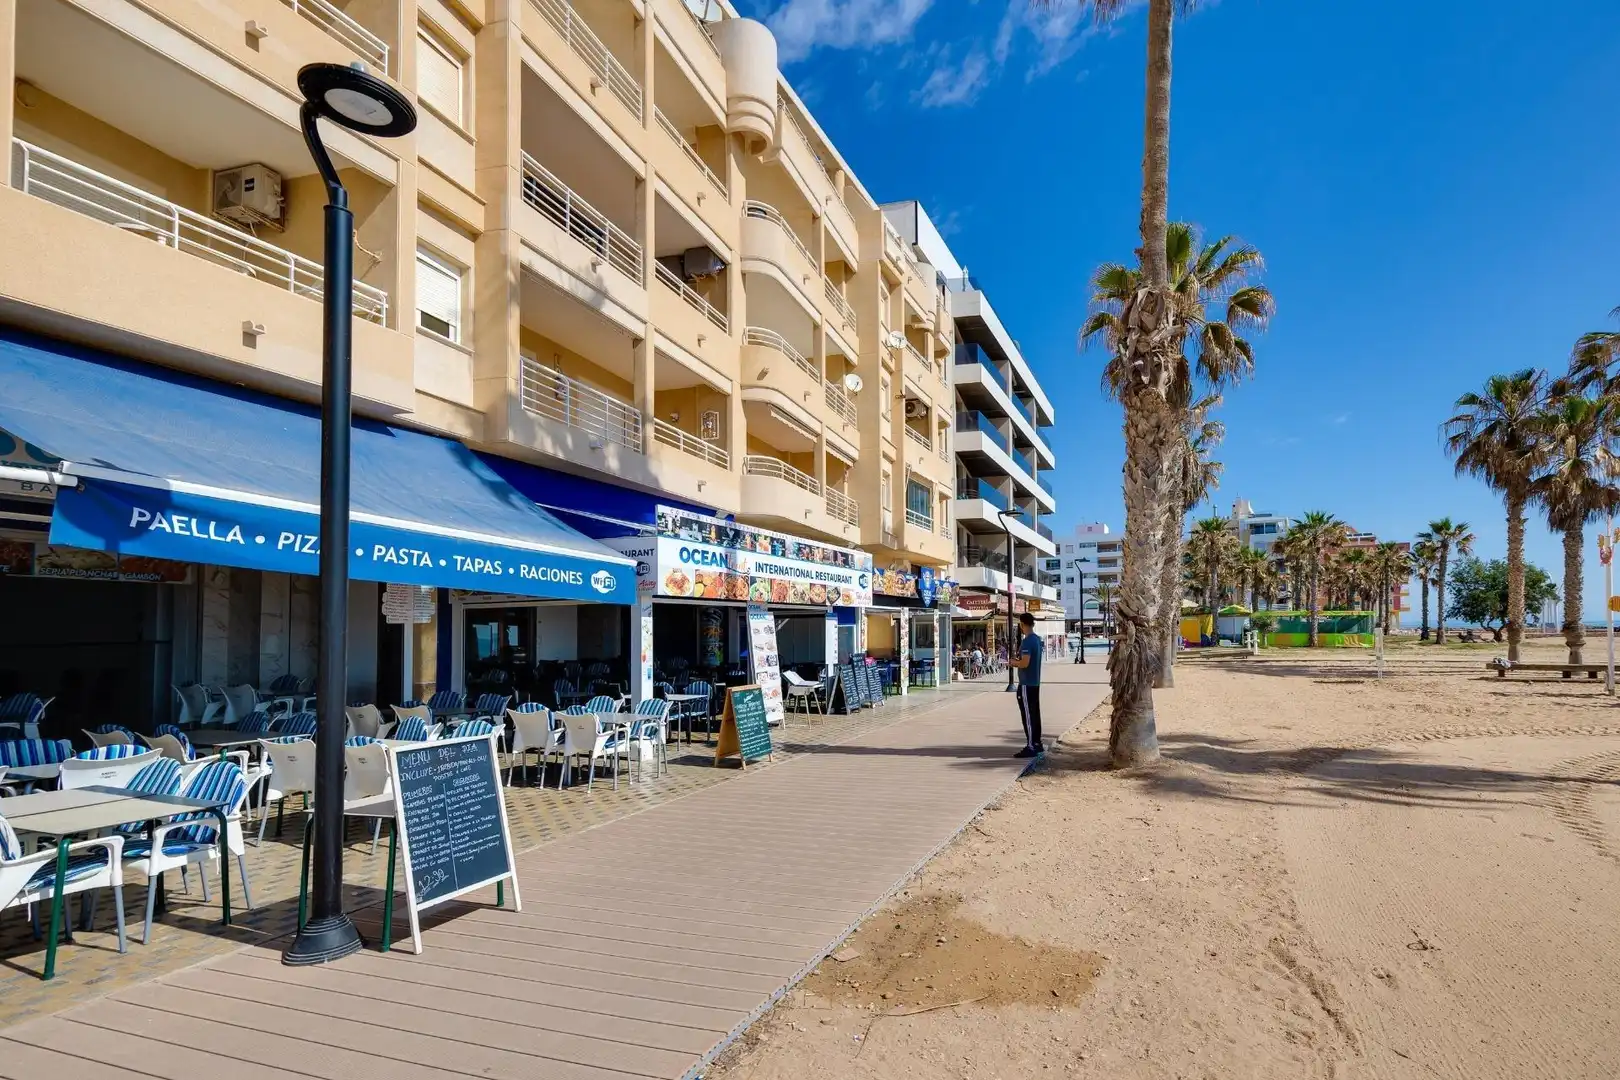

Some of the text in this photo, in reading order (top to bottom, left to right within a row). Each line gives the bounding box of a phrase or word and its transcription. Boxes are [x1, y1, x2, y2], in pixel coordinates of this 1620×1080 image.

[129, 506, 246, 545] PAELLA
[277, 531, 321, 555] PIZ
[372, 544, 433, 568] PASTA
[453, 555, 502, 575] TAPAS
[520, 564, 584, 585] RACIONES
[679, 546, 729, 568] OCEAN
[755, 561, 814, 580] INTERNATIONAL
[815, 570, 853, 585] RESTAURANT
[438, 747, 457, 758] DEL
